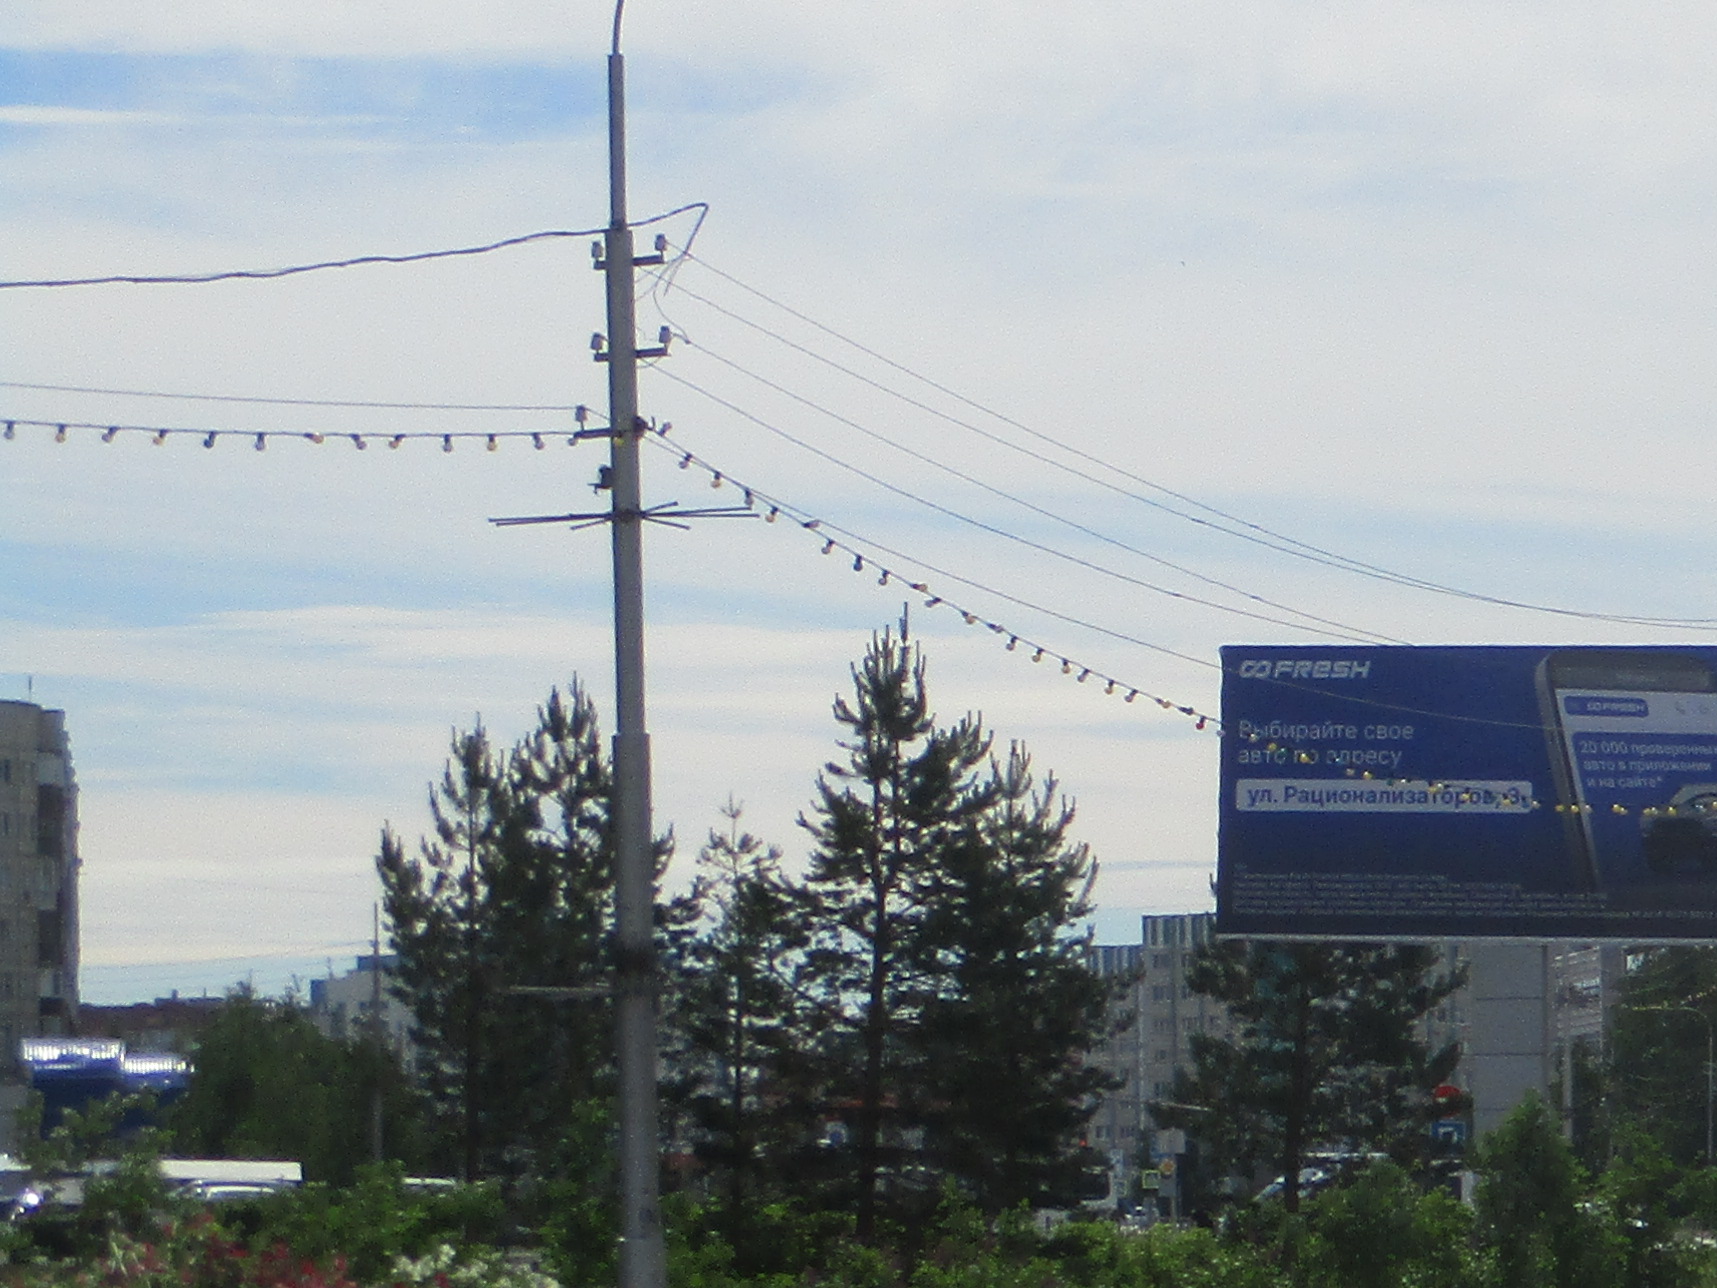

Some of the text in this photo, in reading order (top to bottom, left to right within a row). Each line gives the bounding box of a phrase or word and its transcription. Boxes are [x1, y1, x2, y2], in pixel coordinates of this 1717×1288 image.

[1239, 719, 1415, 743] Выбирайте свое
[1246, 788, 1278, 808] ул.
